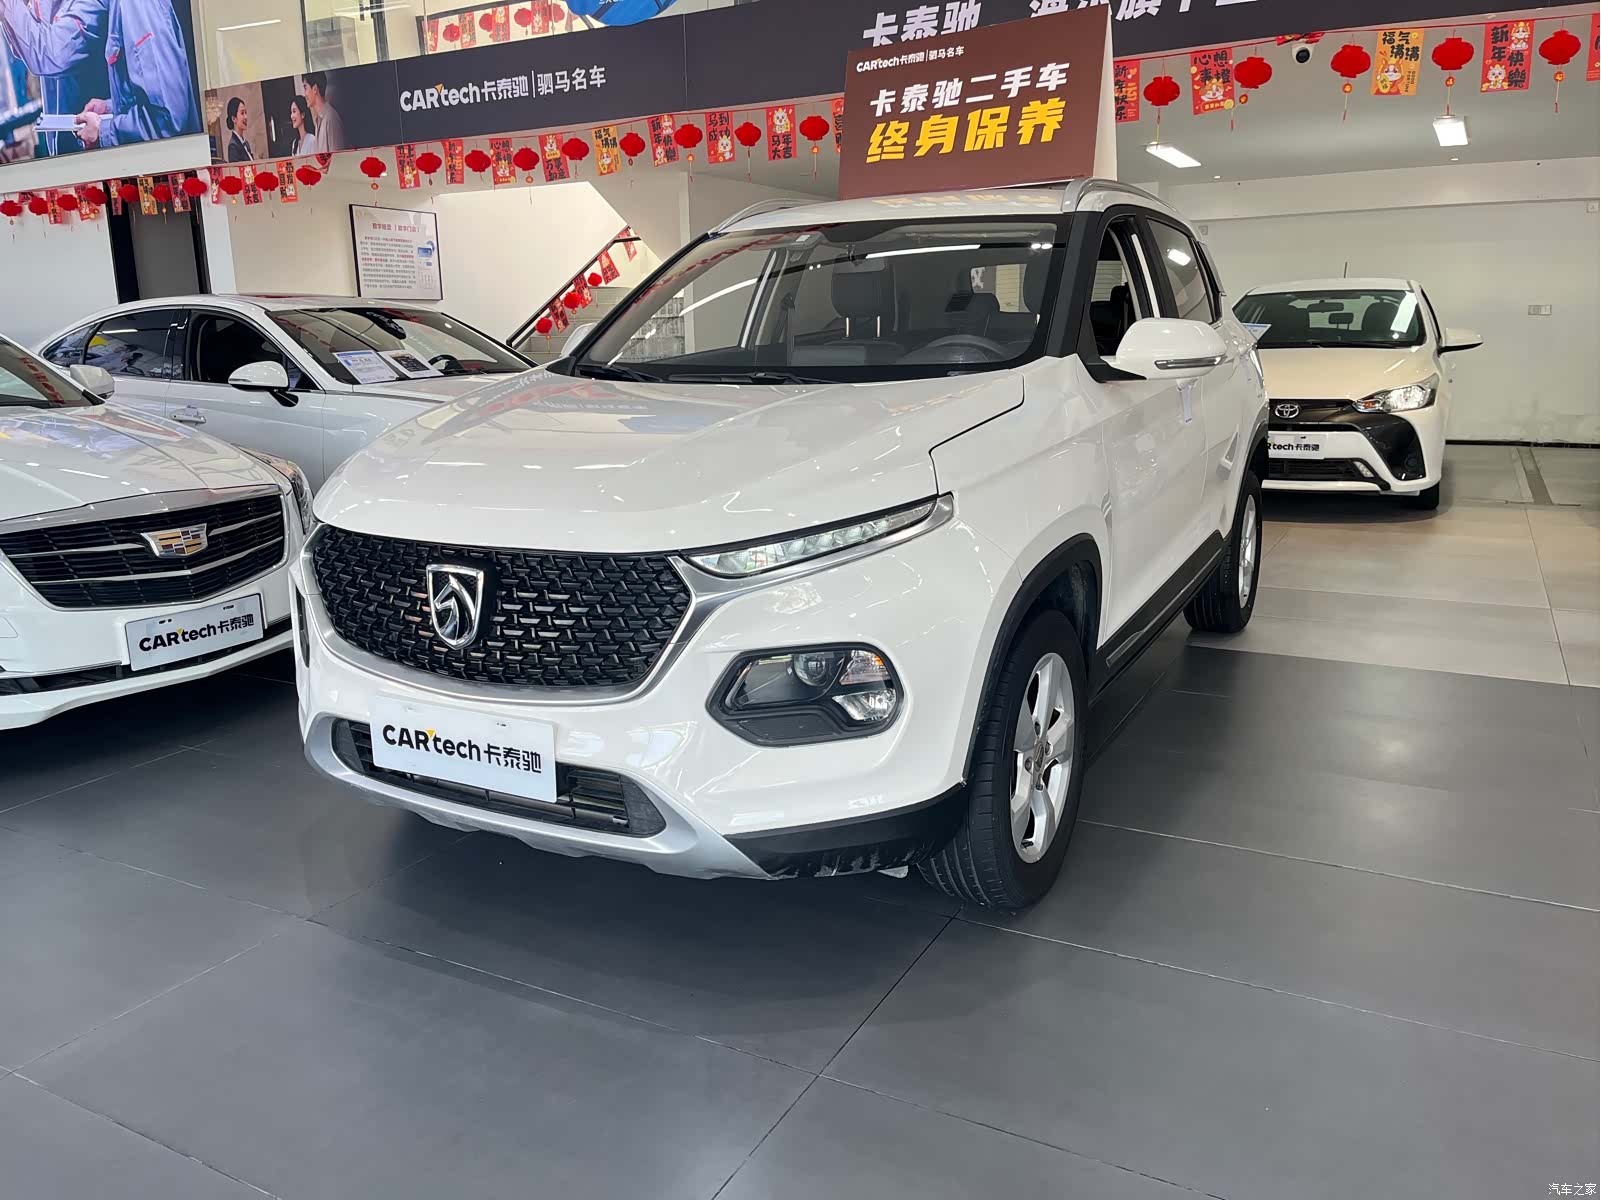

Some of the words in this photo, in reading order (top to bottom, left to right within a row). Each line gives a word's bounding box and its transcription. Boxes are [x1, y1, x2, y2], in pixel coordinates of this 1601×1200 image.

[863, 1, 982, 47] 卡泰驰
[1382, 31, 1410, 45] 福气
[1194, 50, 1228, 68] 心想
[1390, 44, 1420, 61] 满满
[537, 65, 606, 95] 驷马名车
[870, 62, 1070, 117] 卡泰驰二手车
[865, 97, 1066, 163] 终身保养
